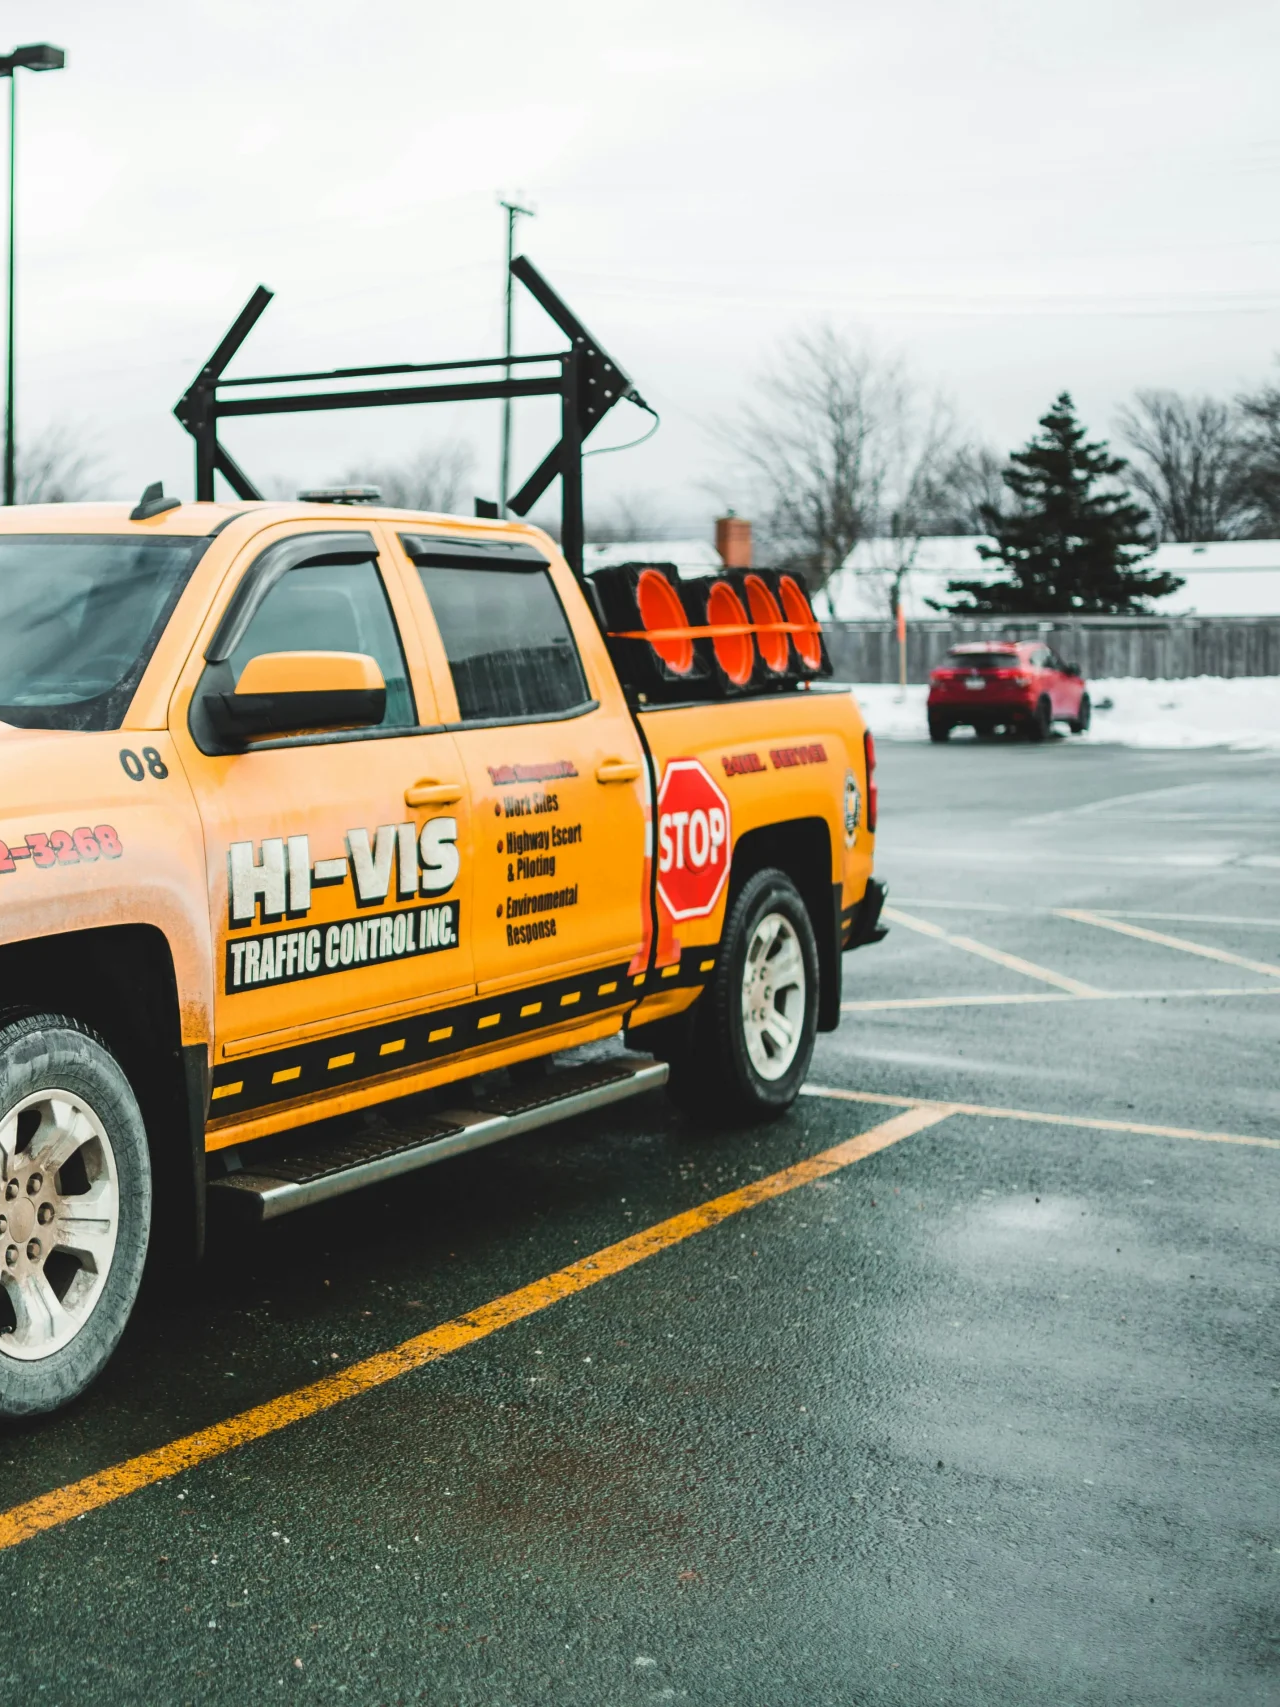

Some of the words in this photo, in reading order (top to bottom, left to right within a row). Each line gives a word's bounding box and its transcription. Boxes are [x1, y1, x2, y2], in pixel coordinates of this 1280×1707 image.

[119, 747, 168, 781] 08
[504, 796, 532, 818] Work
[533, 792, 558, 814] Sites
[506, 830, 549, 855] Highway
[551, 823, 582, 847] Escort
[659, 807, 725, 872] STOP
[226, 816, 460, 930] HI-VIS
[507, 863, 514, 882] &
[517, 854, 555, 880] Piloting
[506, 883, 578, 919] Environmental
[230, 928, 322, 986] TRAFFIC
[324, 912, 416, 969] CONTROL
[419, 905, 457, 950] INC.
[506, 918, 557, 946] Response
